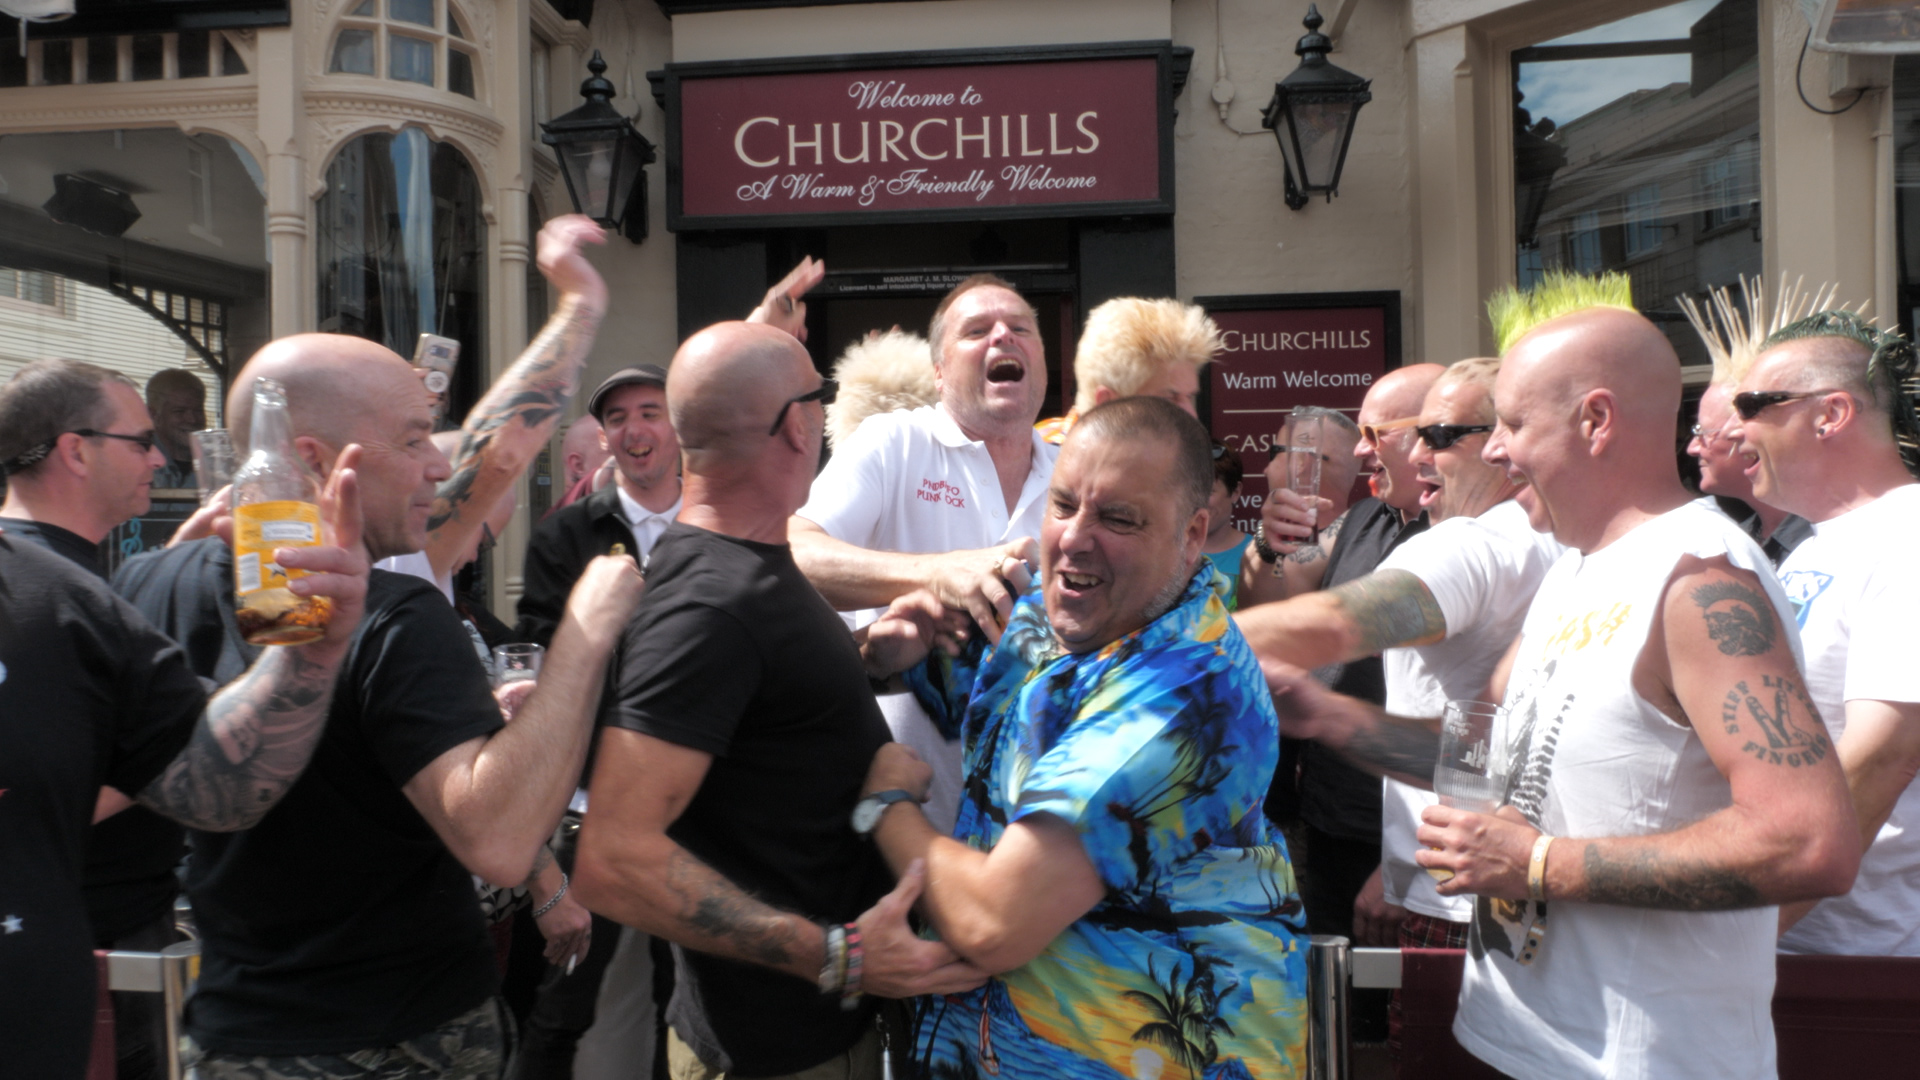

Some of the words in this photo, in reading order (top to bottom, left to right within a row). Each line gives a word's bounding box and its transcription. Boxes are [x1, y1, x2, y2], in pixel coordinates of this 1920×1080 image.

[848, 80, 955, 110] Welcome
[960, 85, 983, 107] to
[734, 111, 1100, 168] CHURCHILLS
[736, 175, 779, 201] A
[781, 173, 856, 200] Warm
[858, 175, 885, 206] &
[886, 168, 995, 201] Friendly
[1001, 164, 1097, 192] Welcome
[889, 281, 926, 291] intoxicating
[927, 281, 946, 290] liquor
[1220, 330, 1371, 352] CHURCHILLS
[1222, 372, 1277, 390] Warm
[1283, 370, 1373, 388] Welcome
[1741, 733, 1828, 768] FINGERS
